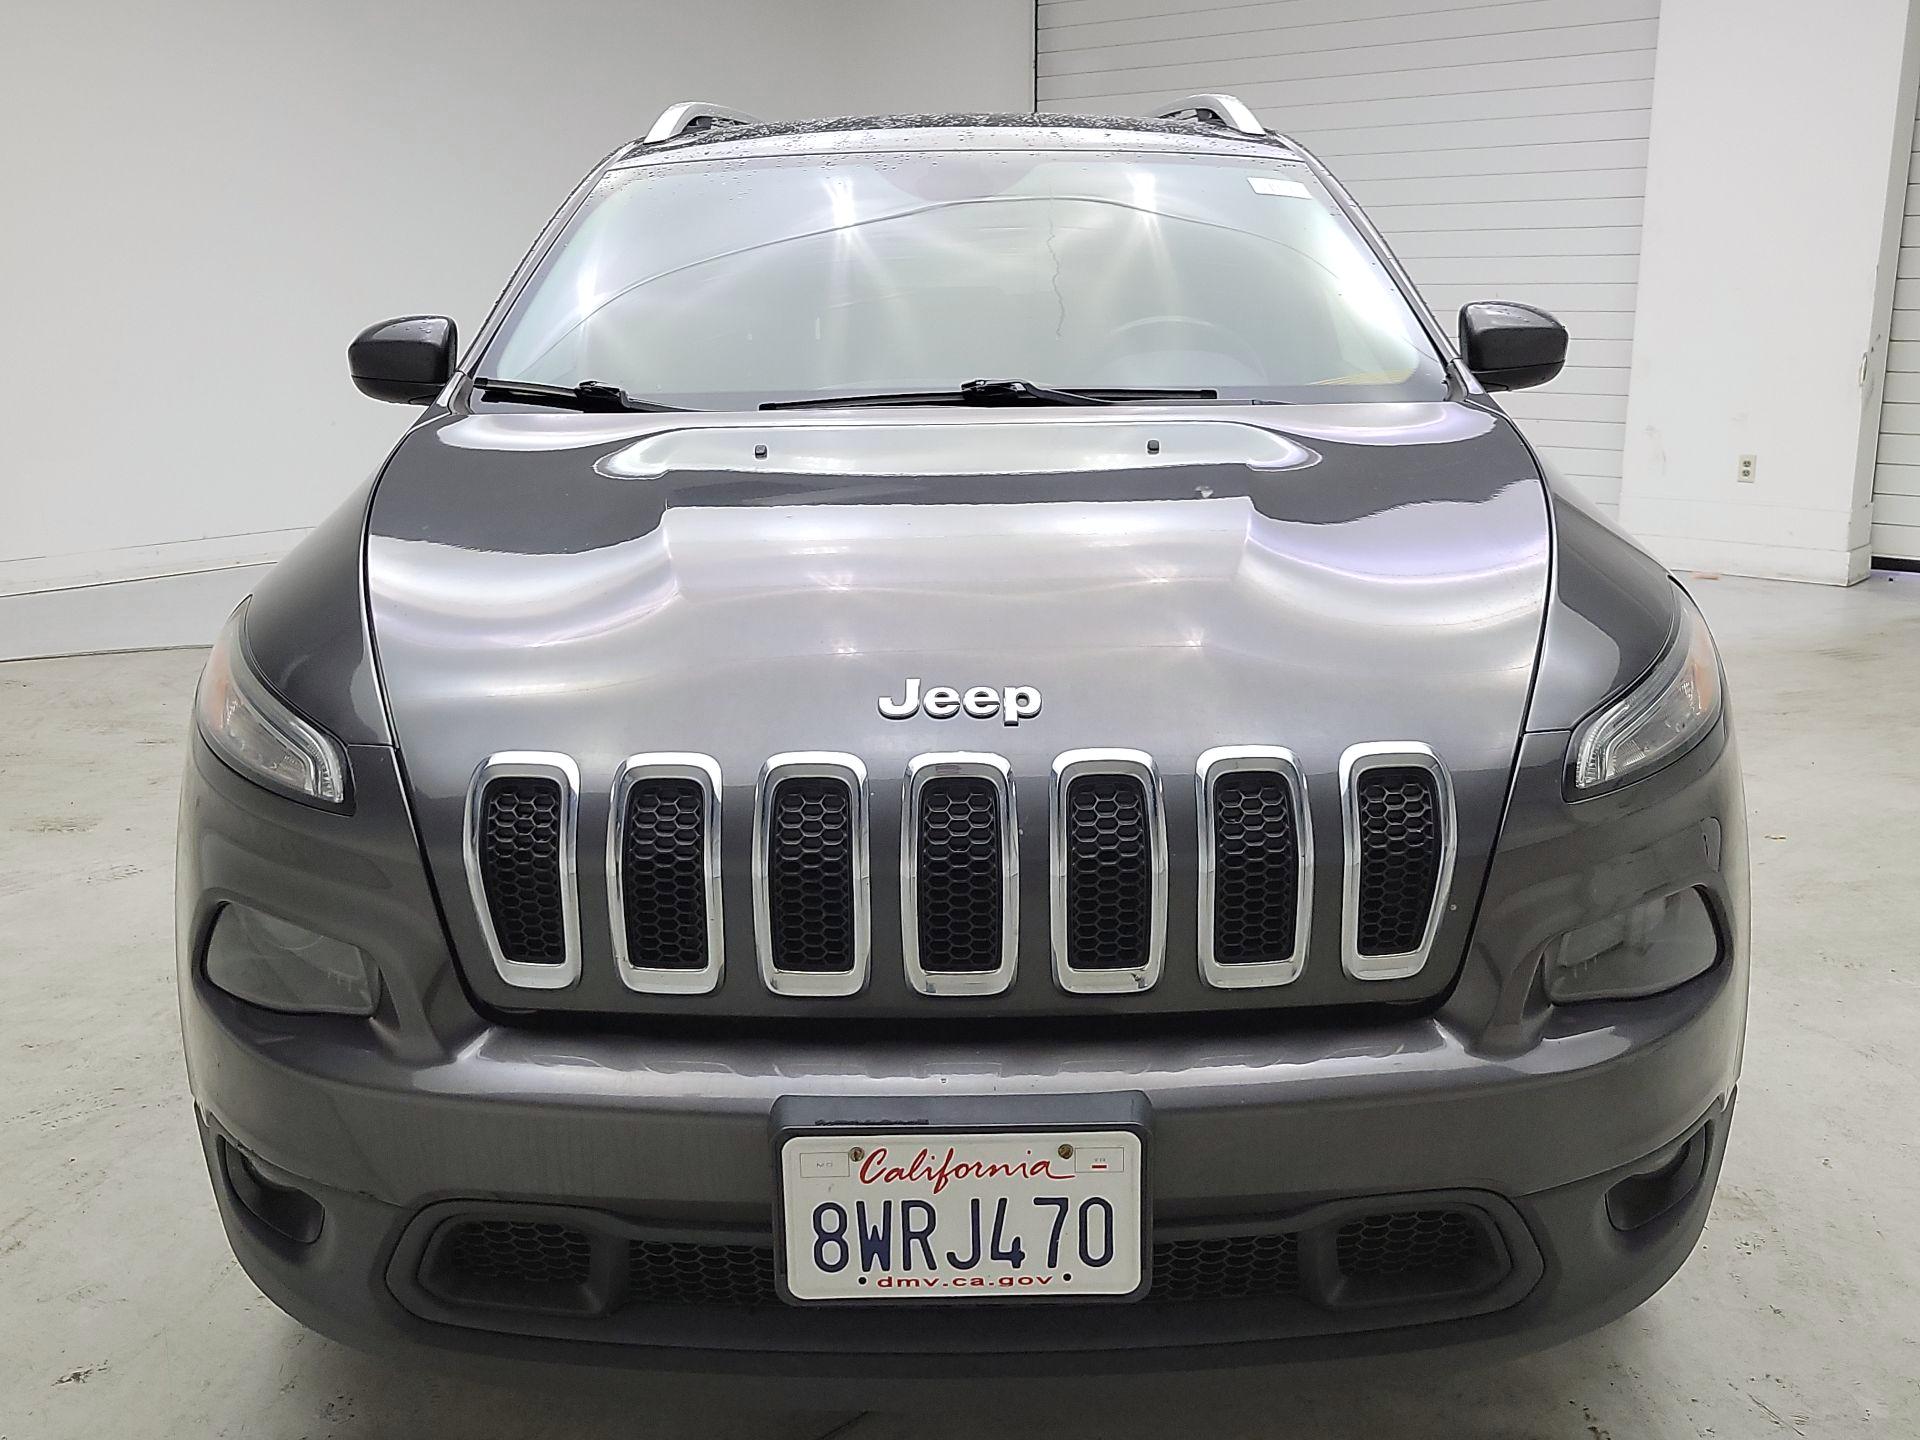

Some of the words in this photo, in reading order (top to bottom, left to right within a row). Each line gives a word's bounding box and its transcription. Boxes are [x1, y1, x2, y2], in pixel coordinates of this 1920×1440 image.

[878, 678, 1042, 727] Jeep
[860, 1147, 1075, 1194] California
[812, 1196, 1115, 1274] 8WRJ470
[877, 1275, 1053, 1288] dmv.ca.gov
